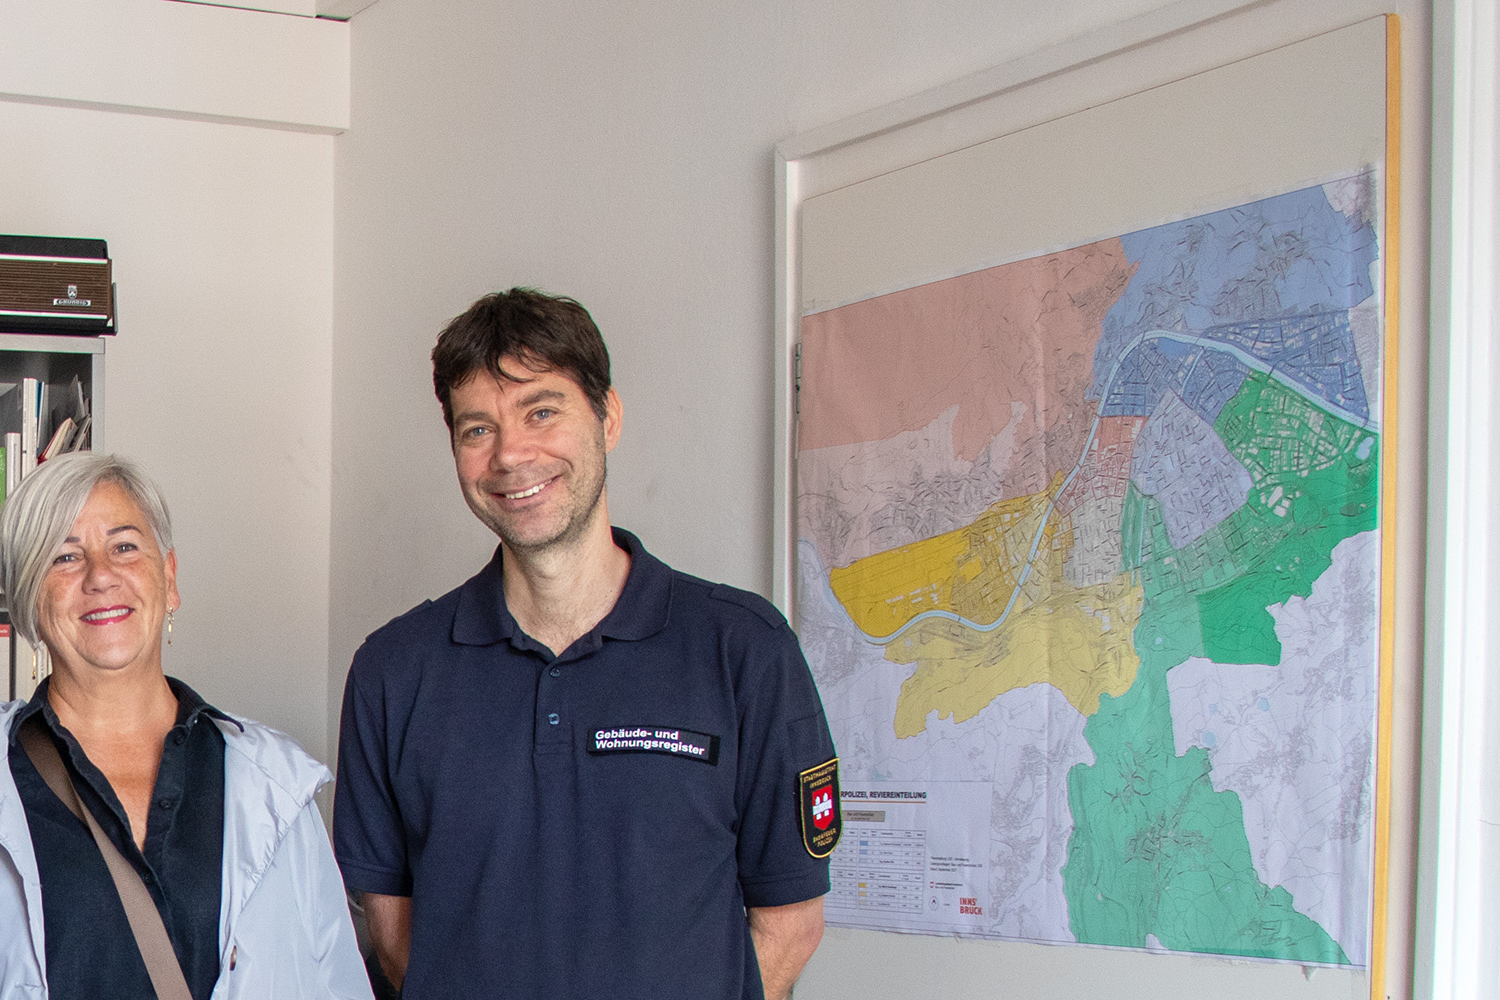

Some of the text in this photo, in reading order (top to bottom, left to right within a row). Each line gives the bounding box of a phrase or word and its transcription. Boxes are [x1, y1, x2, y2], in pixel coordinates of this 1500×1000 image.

[595, 728, 679, 740] Gebäude- und
[595, 739, 705, 756] Wohnungsregister
[869, 791, 927, 799] REVIEREINTEILUNG
[959, 906, 983, 915] BRUCK
